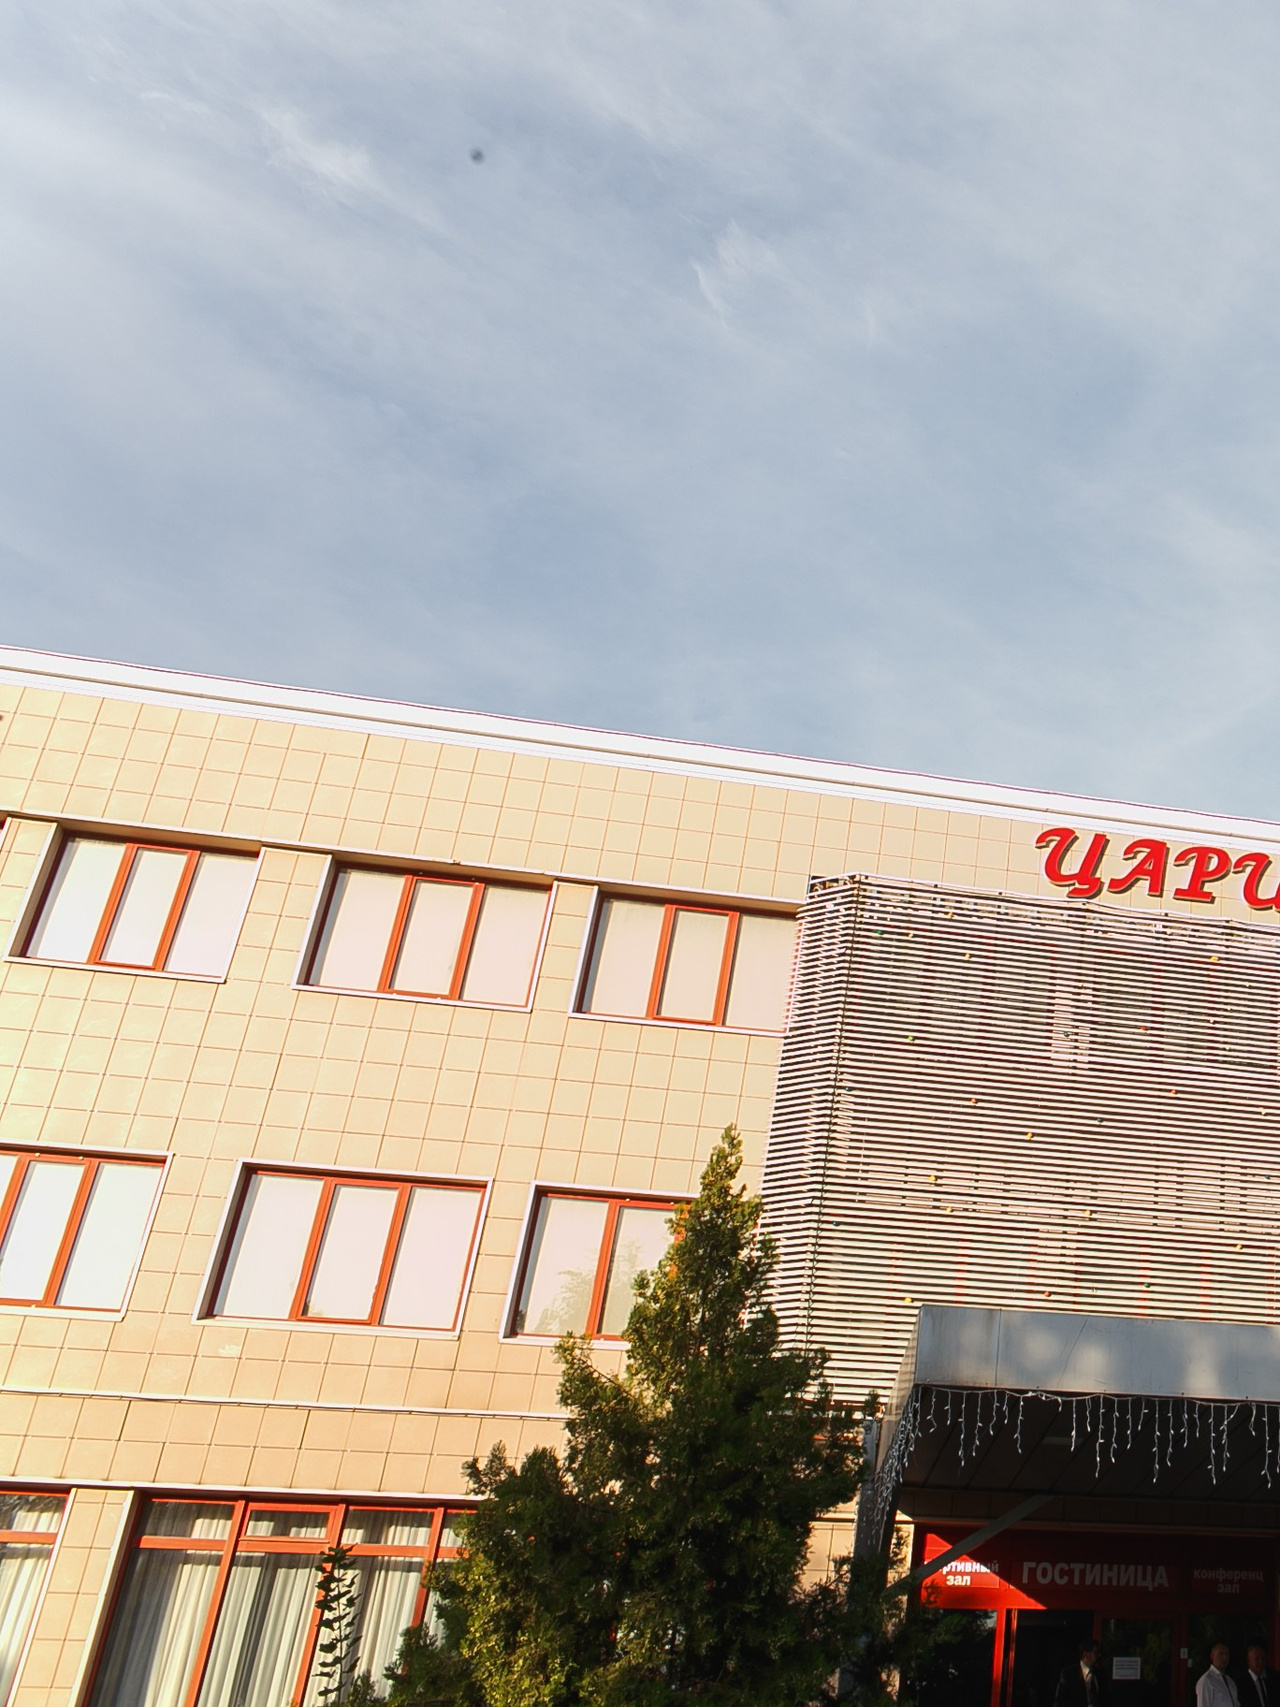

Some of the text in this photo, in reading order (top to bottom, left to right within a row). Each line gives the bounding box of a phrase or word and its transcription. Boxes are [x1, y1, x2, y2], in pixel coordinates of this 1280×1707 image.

[946, 1575, 971, 1586] зал
[1022, 1562, 1169, 1591] ГОСТИНИЦА
[1193, 1567, 1265, 1583] конференц
[1217, 1583, 1240, 1594] зал
